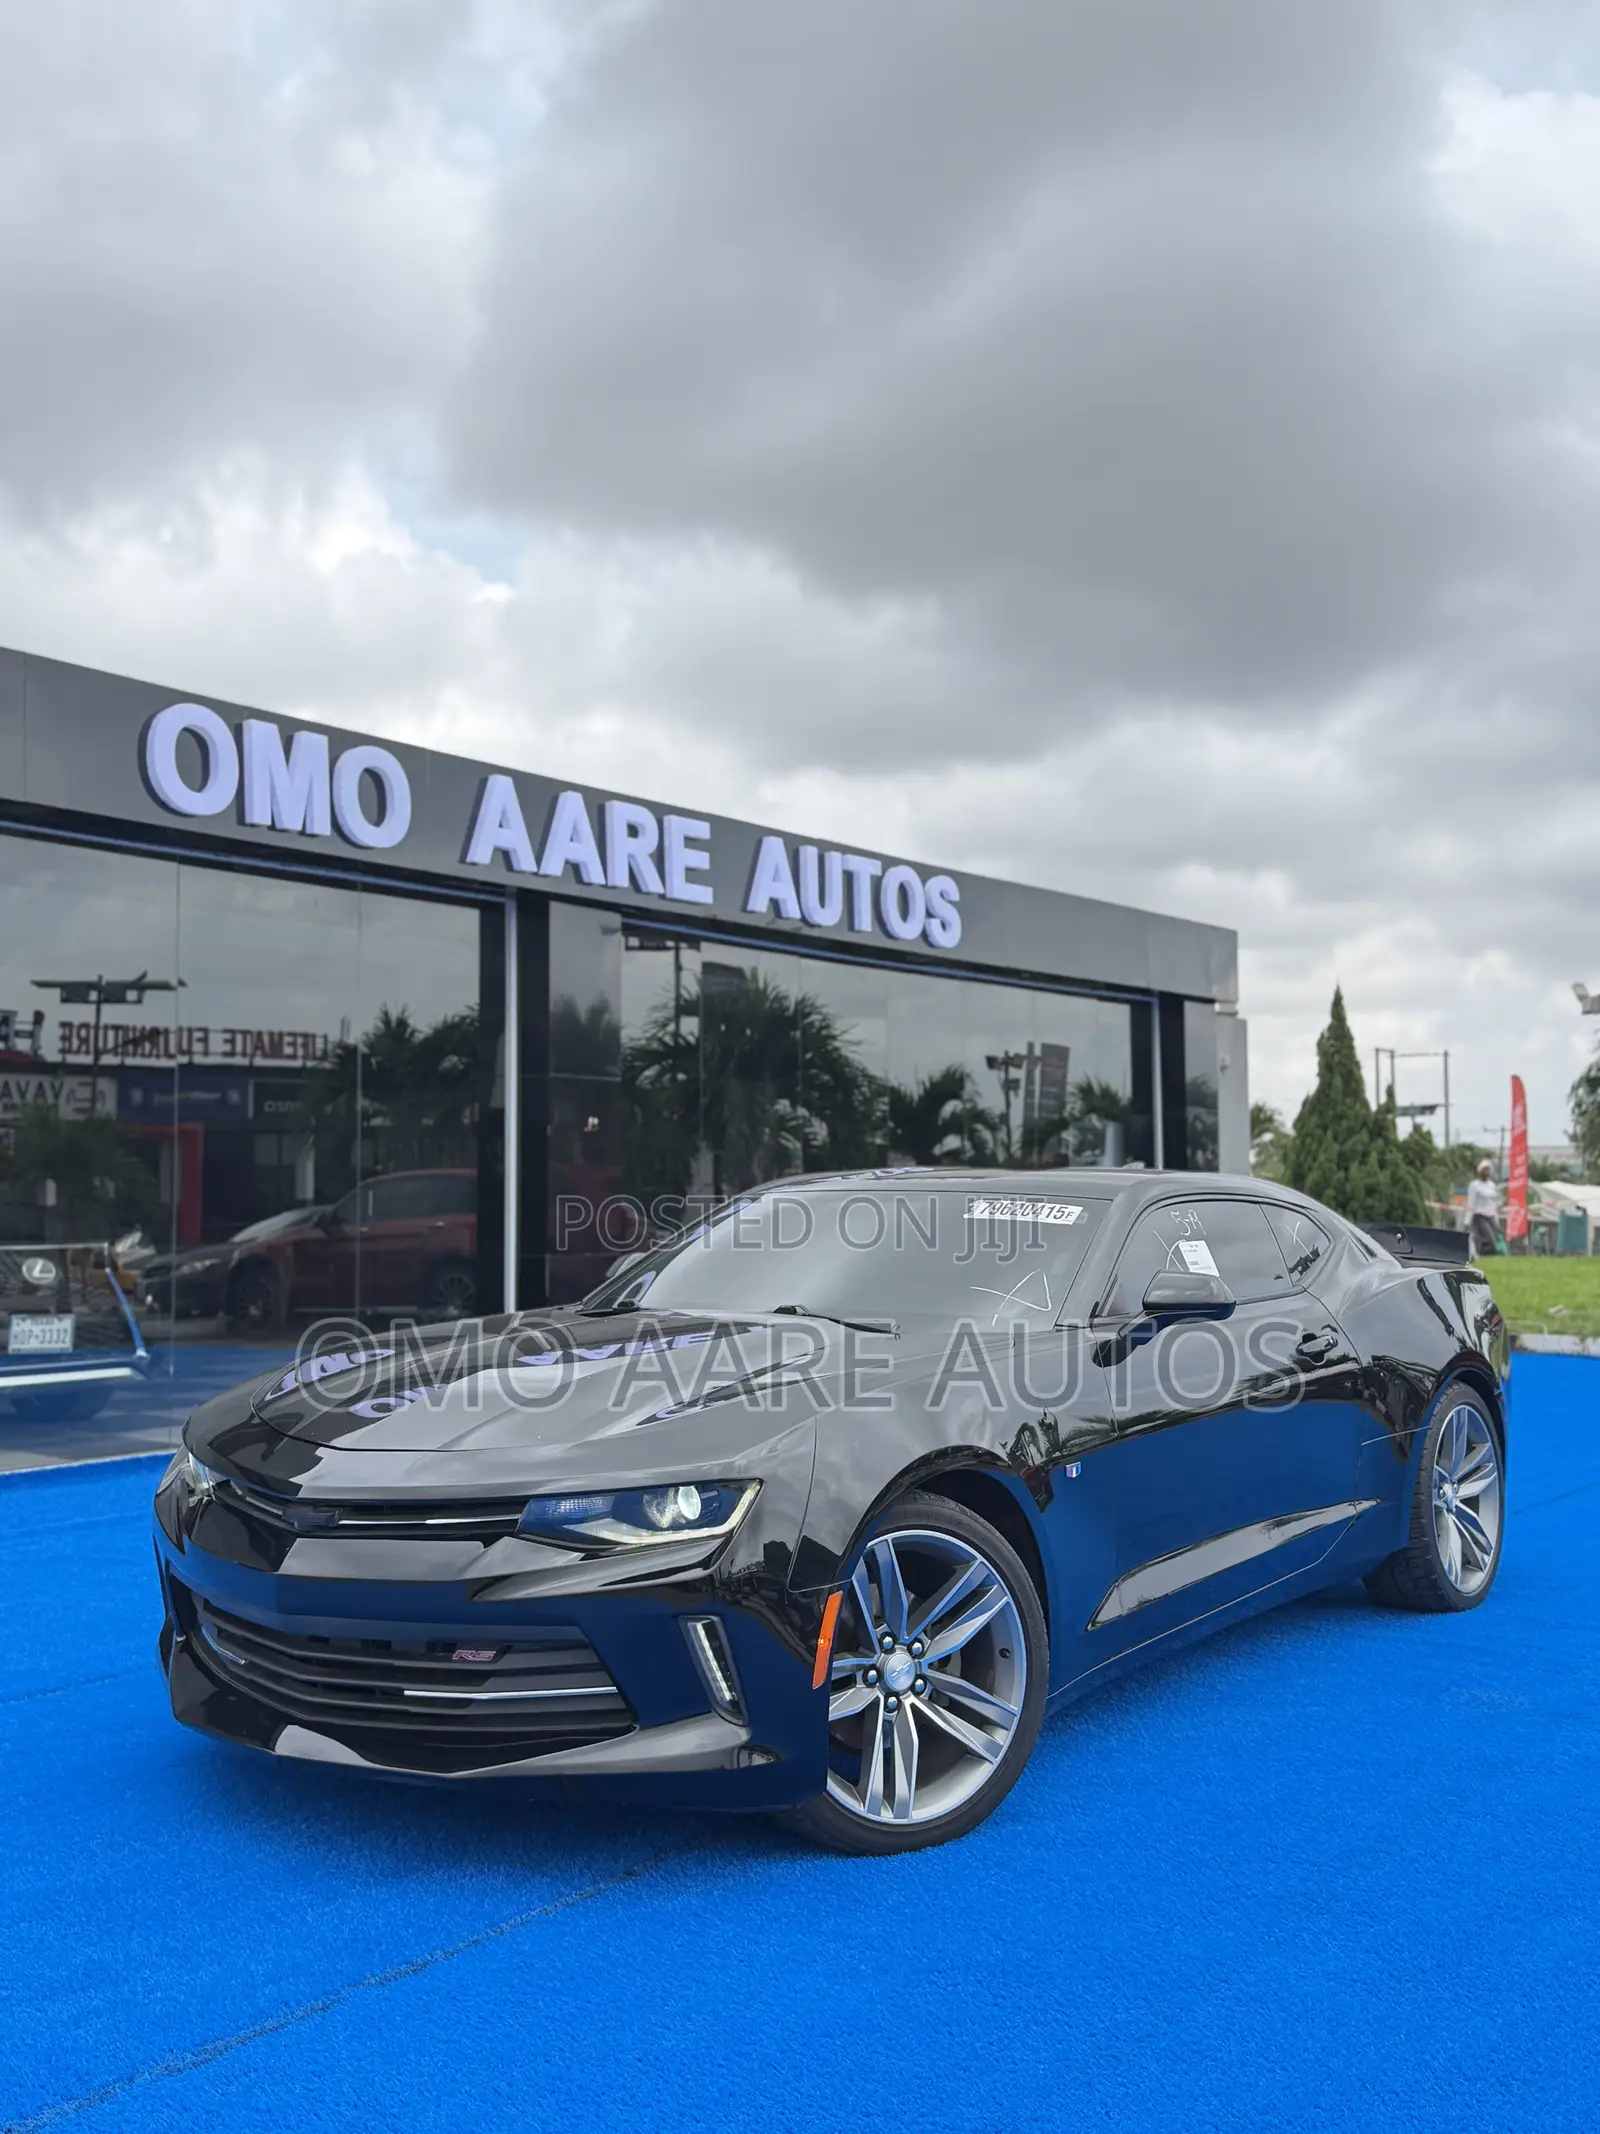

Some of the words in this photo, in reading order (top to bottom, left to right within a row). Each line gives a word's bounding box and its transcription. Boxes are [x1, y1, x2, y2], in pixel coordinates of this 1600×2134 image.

[141, 702, 412, 849] OMO
[465, 773, 714, 905] AARE
[745, 835, 962, 949] AUTOS
[452, 1648, 497, 1662] RS
